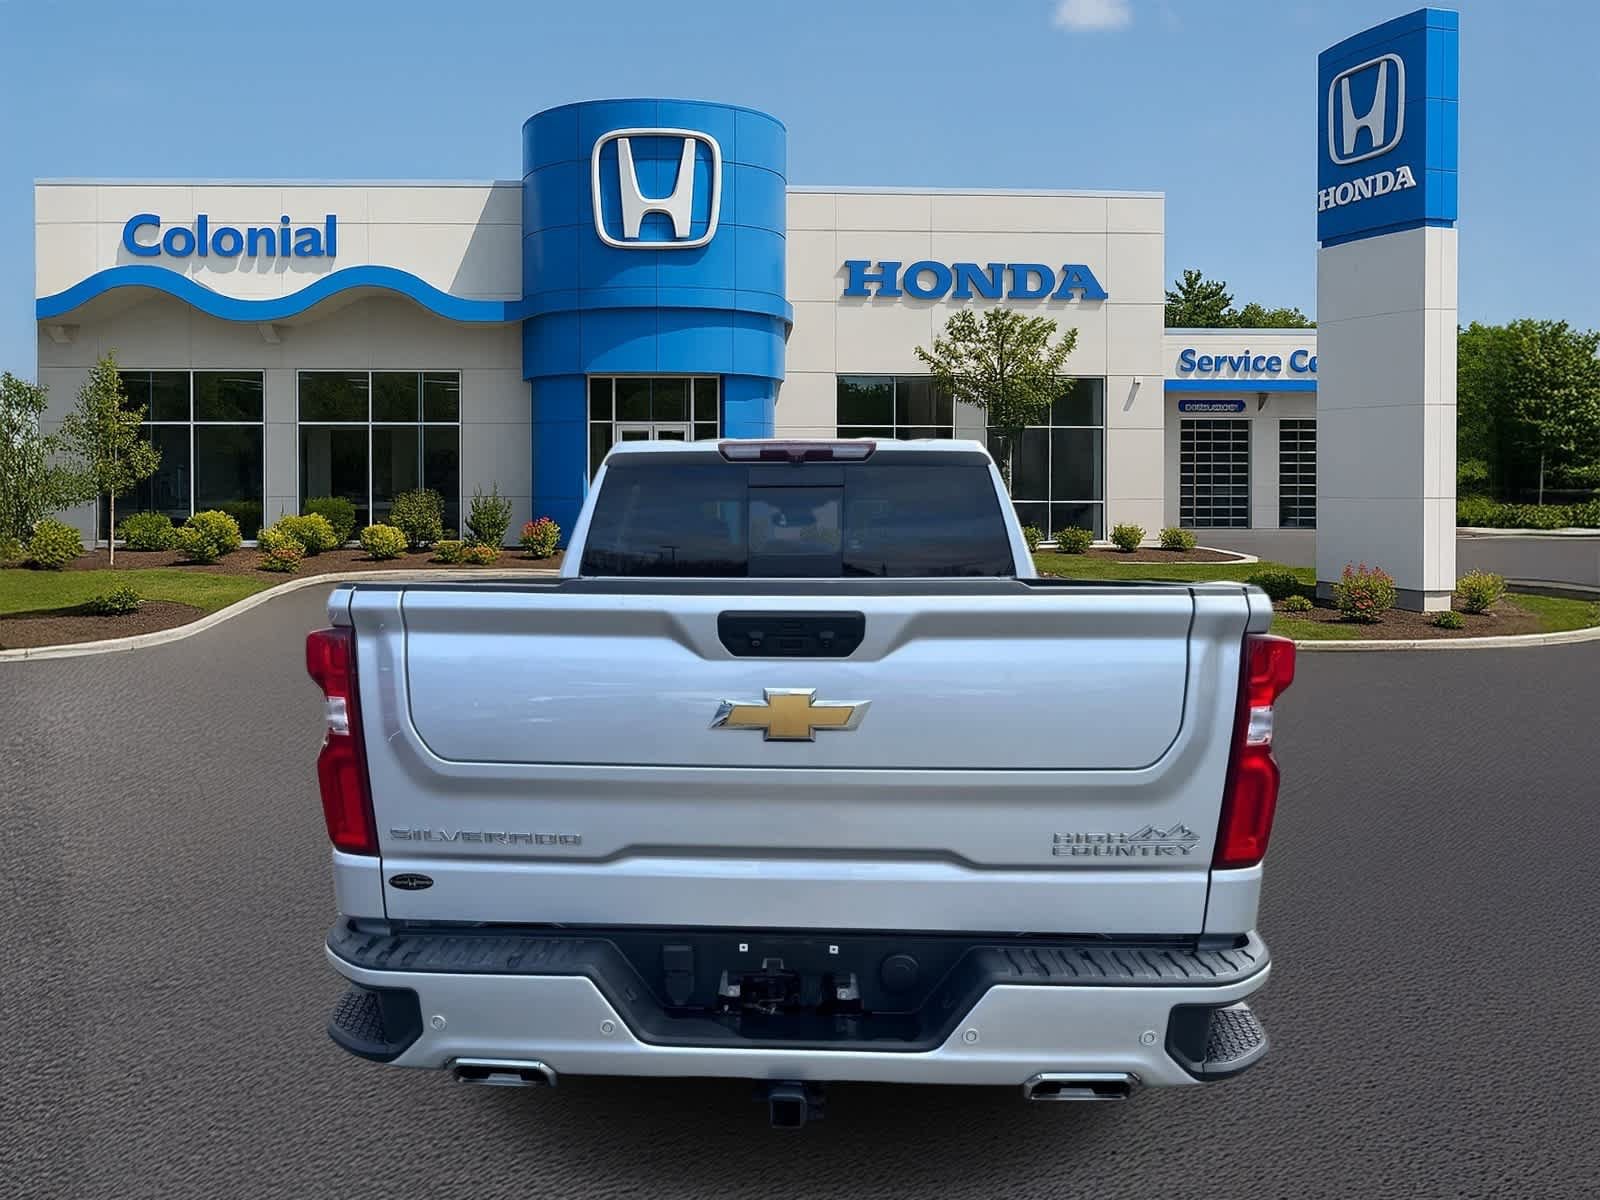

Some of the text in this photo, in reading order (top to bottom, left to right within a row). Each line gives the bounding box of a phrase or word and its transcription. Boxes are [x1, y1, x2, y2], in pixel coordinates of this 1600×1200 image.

[1318, 165, 1417, 212] HONDA
[122, 213, 337, 257] Colonial
[844, 260, 1109, 300] HONDA
[1179, 348, 1282, 373] Service
[390, 827, 582, 846] SILVERADO
[1052, 832, 1130, 844] HIGH
[1051, 842, 1199, 857] COUNTRY
